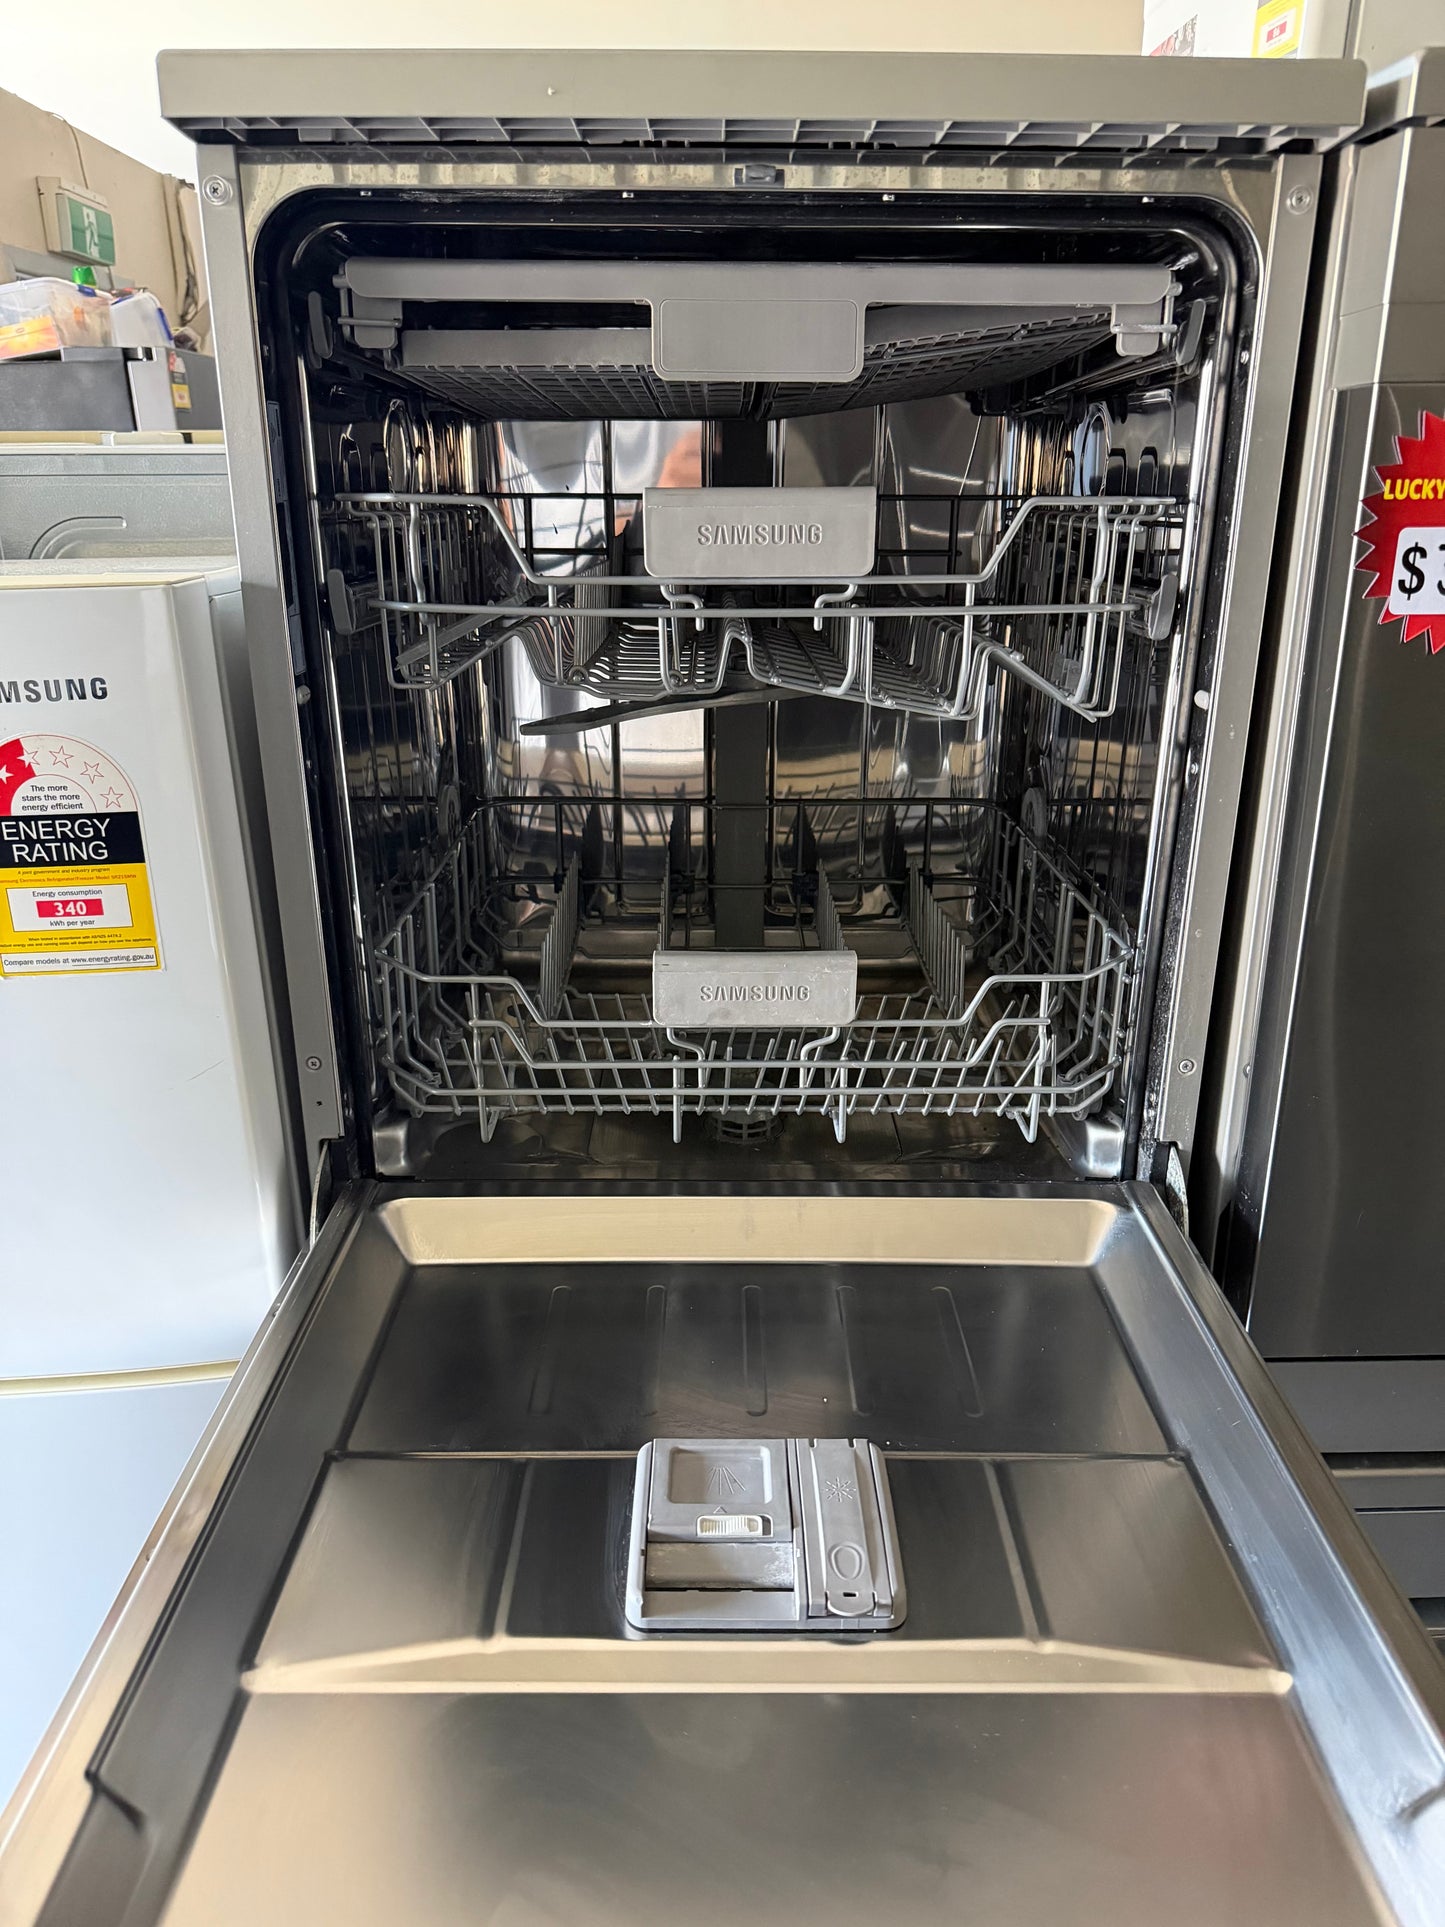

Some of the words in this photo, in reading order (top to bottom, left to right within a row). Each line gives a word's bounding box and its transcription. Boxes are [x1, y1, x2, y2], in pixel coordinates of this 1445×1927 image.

[1383, 478, 1445, 500] LUCKY
[698, 524, 823, 546] SAMSUNG
[1, 818, 110, 840] ENERGY
[12, 841, 109, 863] RATING
[57, 889, 103, 897] consumption
[53, 901, 87, 916] 340
[4, 959, 34, 967] Compare
[71, 954, 154, 963] www.energyrating.gov.au
[700, 985, 811, 1002] SAMSUNG
